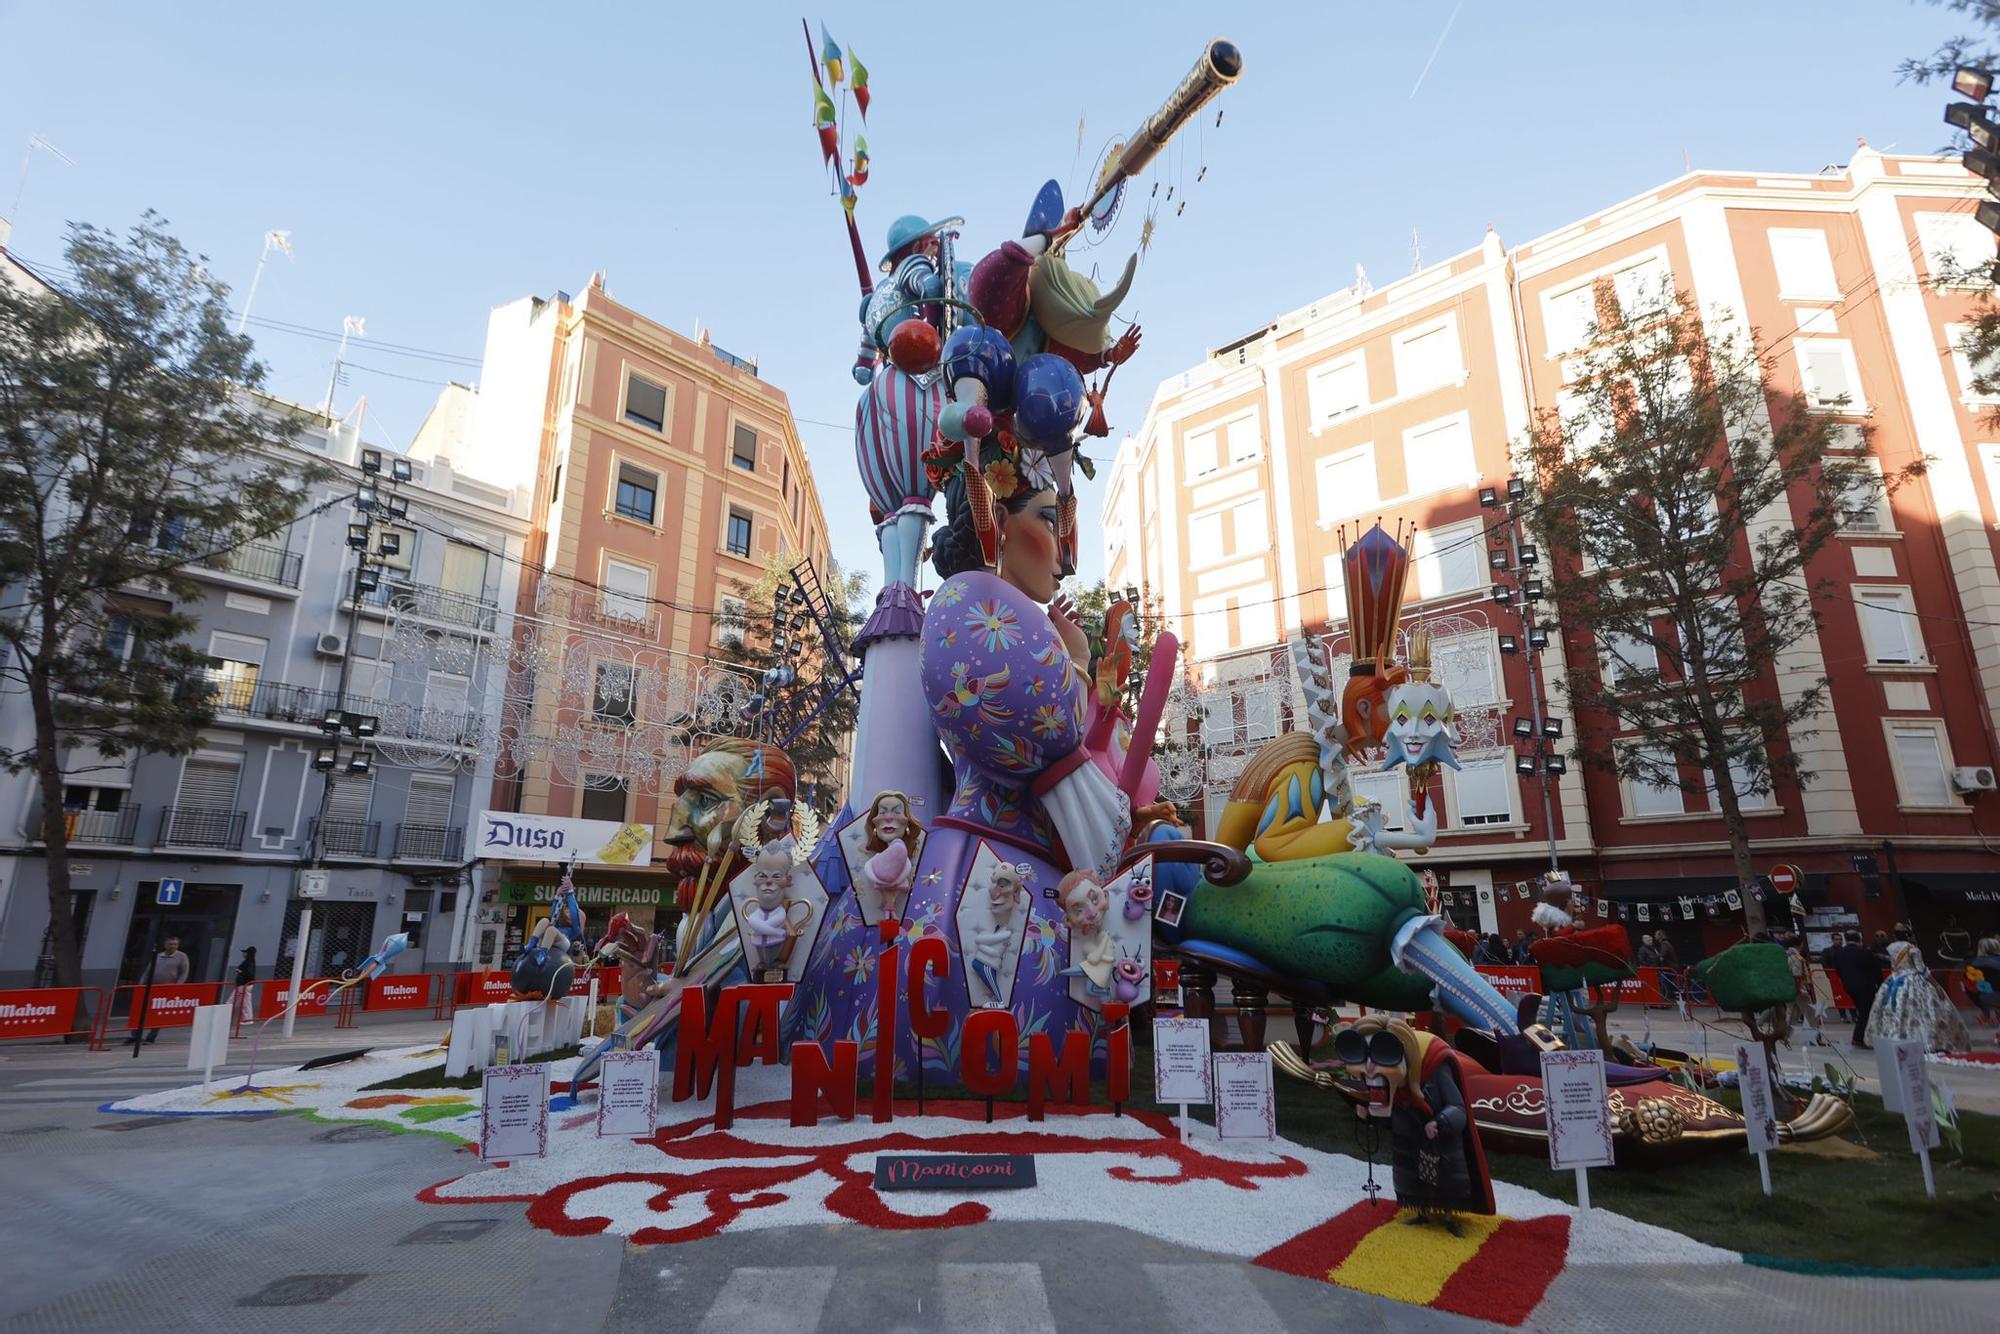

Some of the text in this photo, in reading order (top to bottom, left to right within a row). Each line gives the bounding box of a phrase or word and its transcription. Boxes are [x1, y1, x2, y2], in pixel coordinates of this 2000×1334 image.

[484, 819, 565, 850] Duso
[534, 884, 661, 904] SURMERCADO
[1487, 975, 1527, 986] Mahou
[276, 990, 316, 1002] Mou
[383, 985, 418, 996] Mahou
[0, 1003, 56, 1017] Mahou
[151, 996, 200, 1010] Mahou
[888, 1159, 1016, 1183] Manicomi
